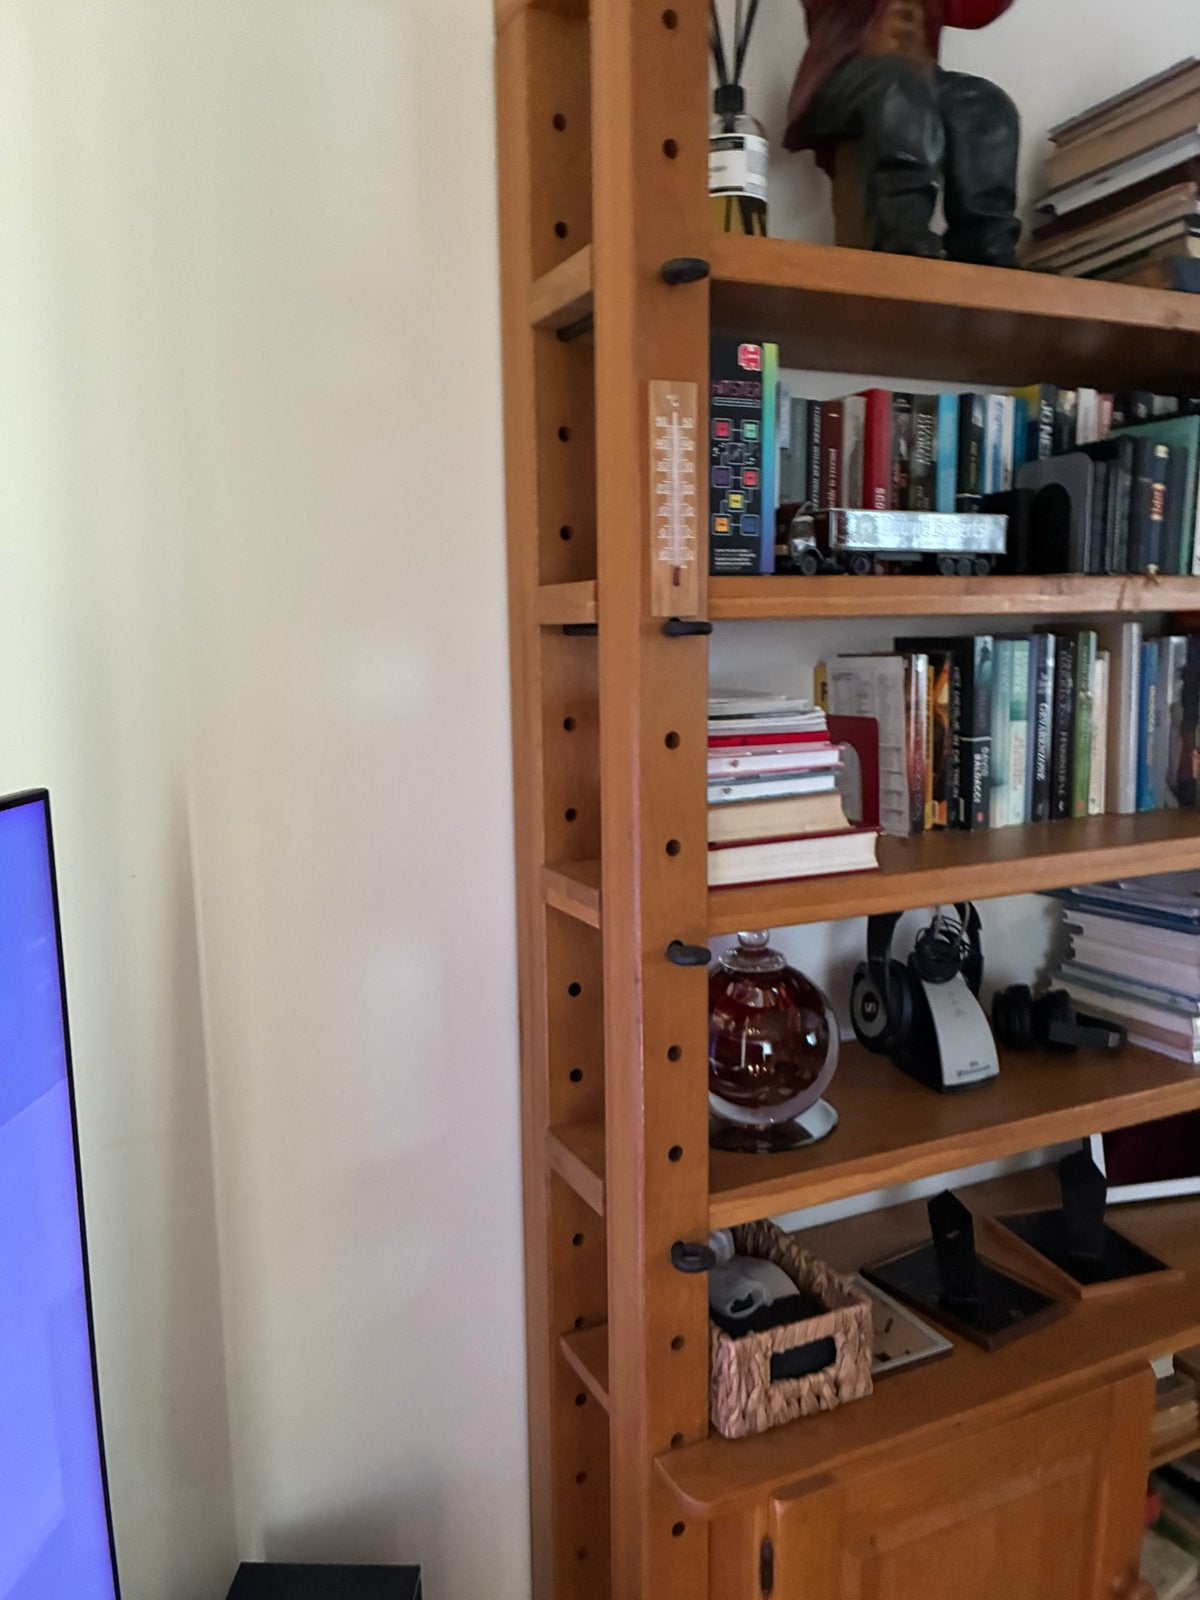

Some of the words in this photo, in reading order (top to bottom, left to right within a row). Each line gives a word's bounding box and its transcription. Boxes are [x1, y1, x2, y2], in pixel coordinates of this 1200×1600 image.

[972, 753, 983, 804] BALDACCI
[980, 746, 990, 777] DAVID
[1057, 730, 1069, 795] HANNIBAL
